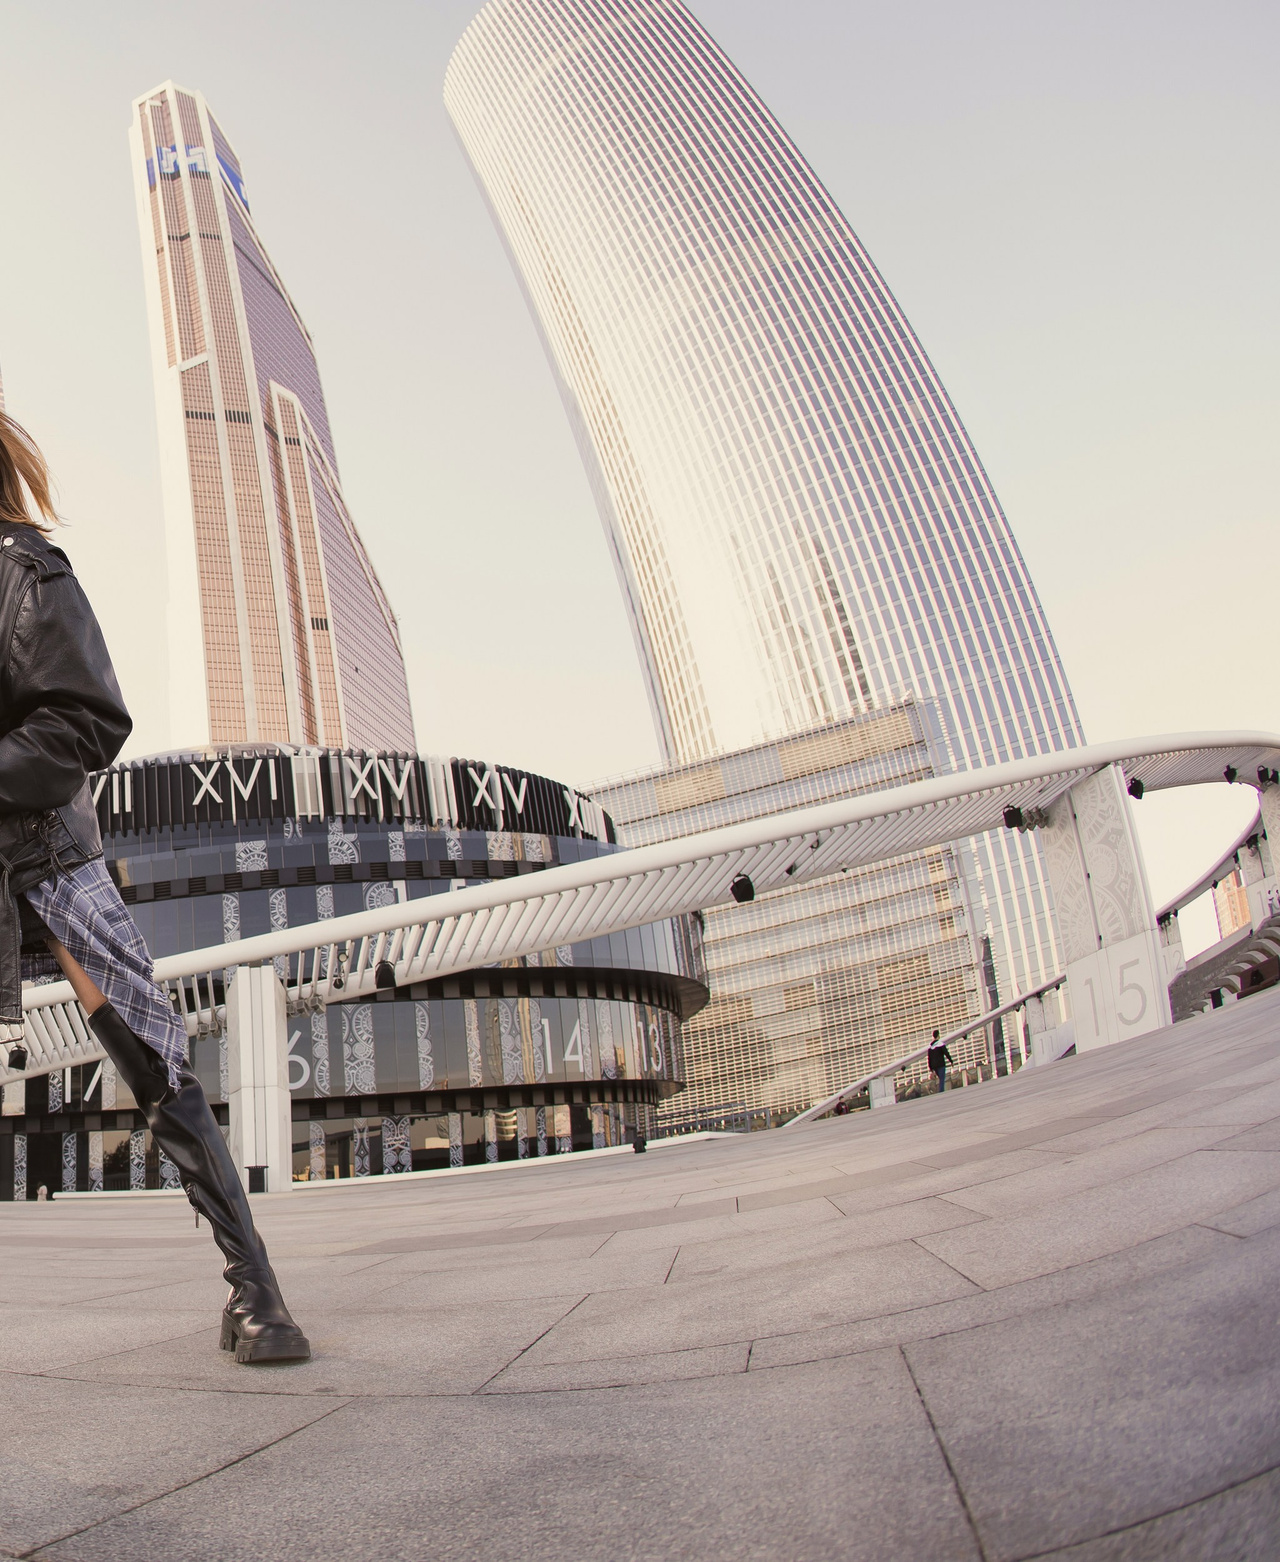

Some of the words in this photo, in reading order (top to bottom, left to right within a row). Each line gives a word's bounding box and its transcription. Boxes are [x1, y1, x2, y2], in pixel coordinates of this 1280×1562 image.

[189, 758, 278, 806] XVI
[345, 758, 414, 801] XV
[467, 767, 528, 815] XIV
[1162, 950, 1185, 975] 12
[1083, 958, 1148, 1037] 15
[541, 1018, 584, 1074] 14
[637, 1021, 663, 1072] 13
